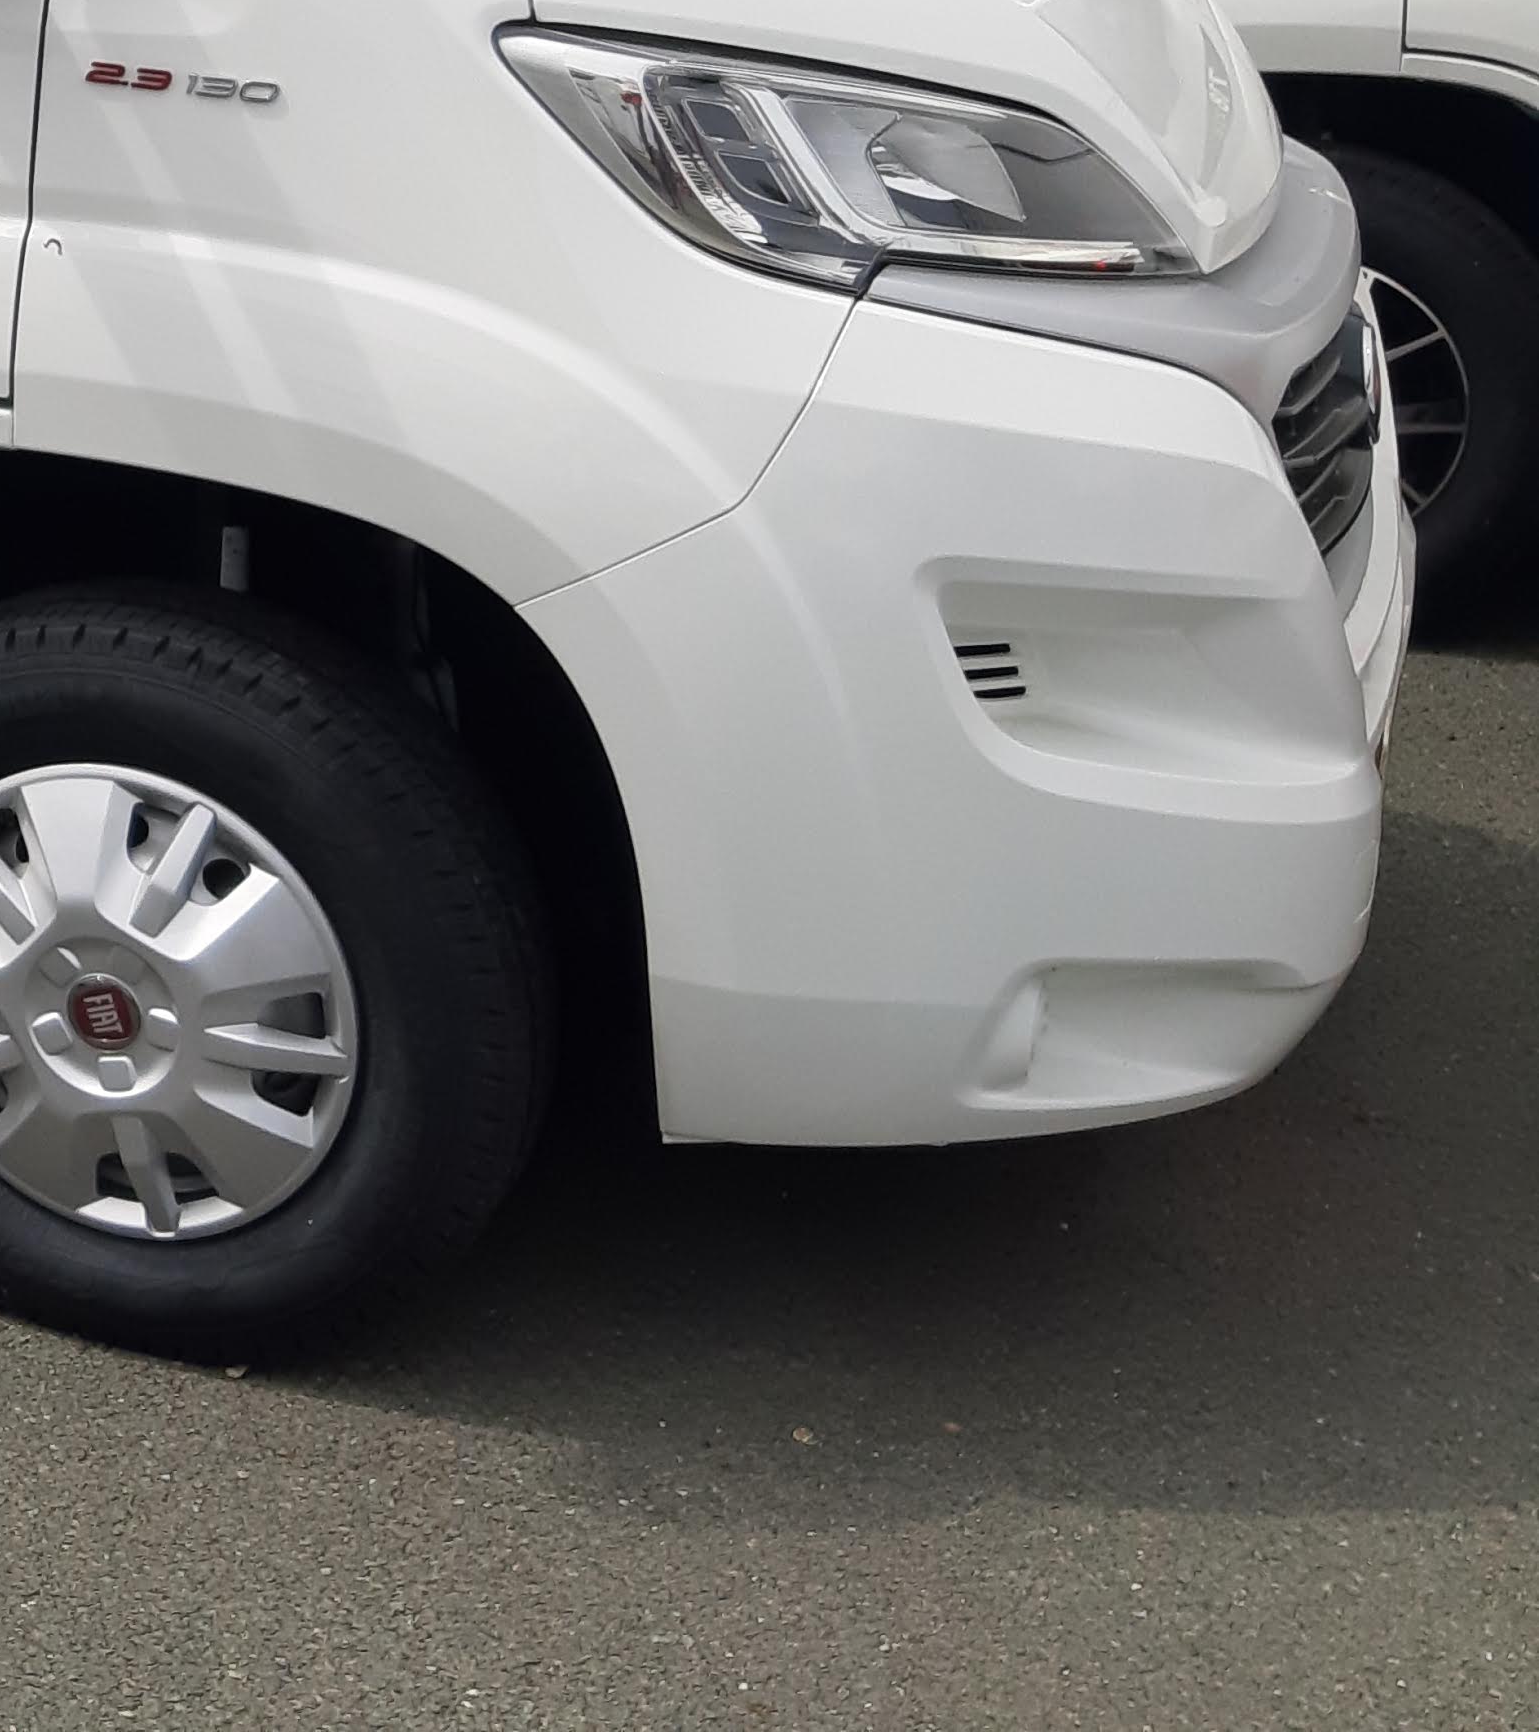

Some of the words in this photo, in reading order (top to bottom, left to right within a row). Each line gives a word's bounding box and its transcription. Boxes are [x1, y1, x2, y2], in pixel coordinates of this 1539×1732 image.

[85, 61, 173, 91] 2.3
[185, 71, 281, 103] 130
[82, 993, 124, 1034] FIAT
